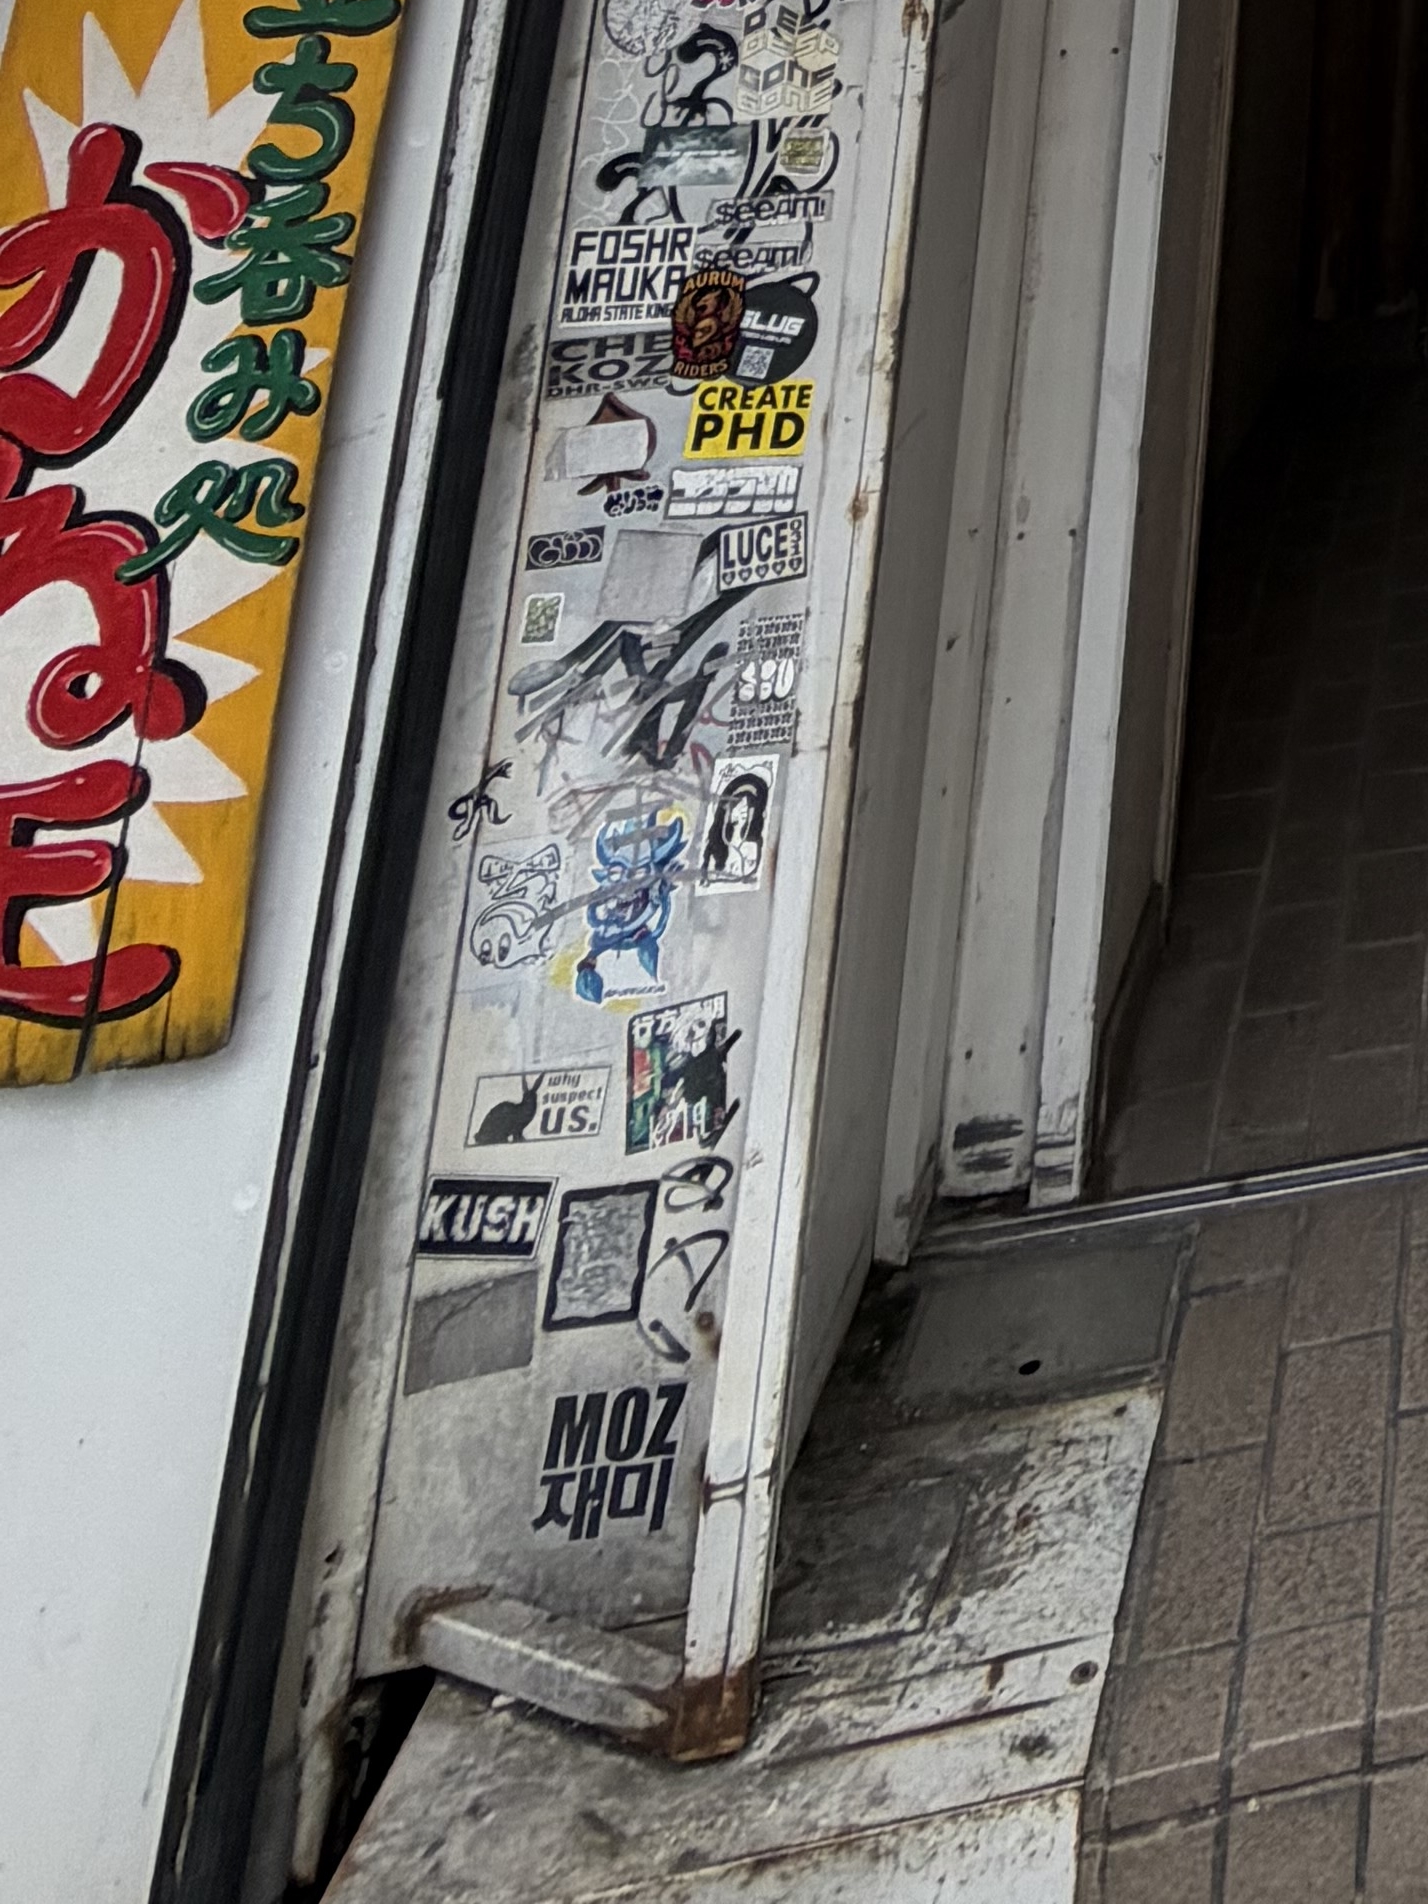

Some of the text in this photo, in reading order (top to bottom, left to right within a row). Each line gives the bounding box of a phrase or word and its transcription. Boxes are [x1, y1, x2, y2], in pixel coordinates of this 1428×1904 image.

[673, 360, 730, 377] RIDERS
[698, 384, 813, 411] CREATE
[691, 411, 807, 452] PHD
[540, 1086, 605, 1106] suspect
[546, 1072, 582, 1089] why
[539, 1105, 599, 1137] US.
[419, 1194, 547, 1245] KUSH
[543, 1383, 690, 1471] MOZ
[532, 1456, 674, 1542] 재미
